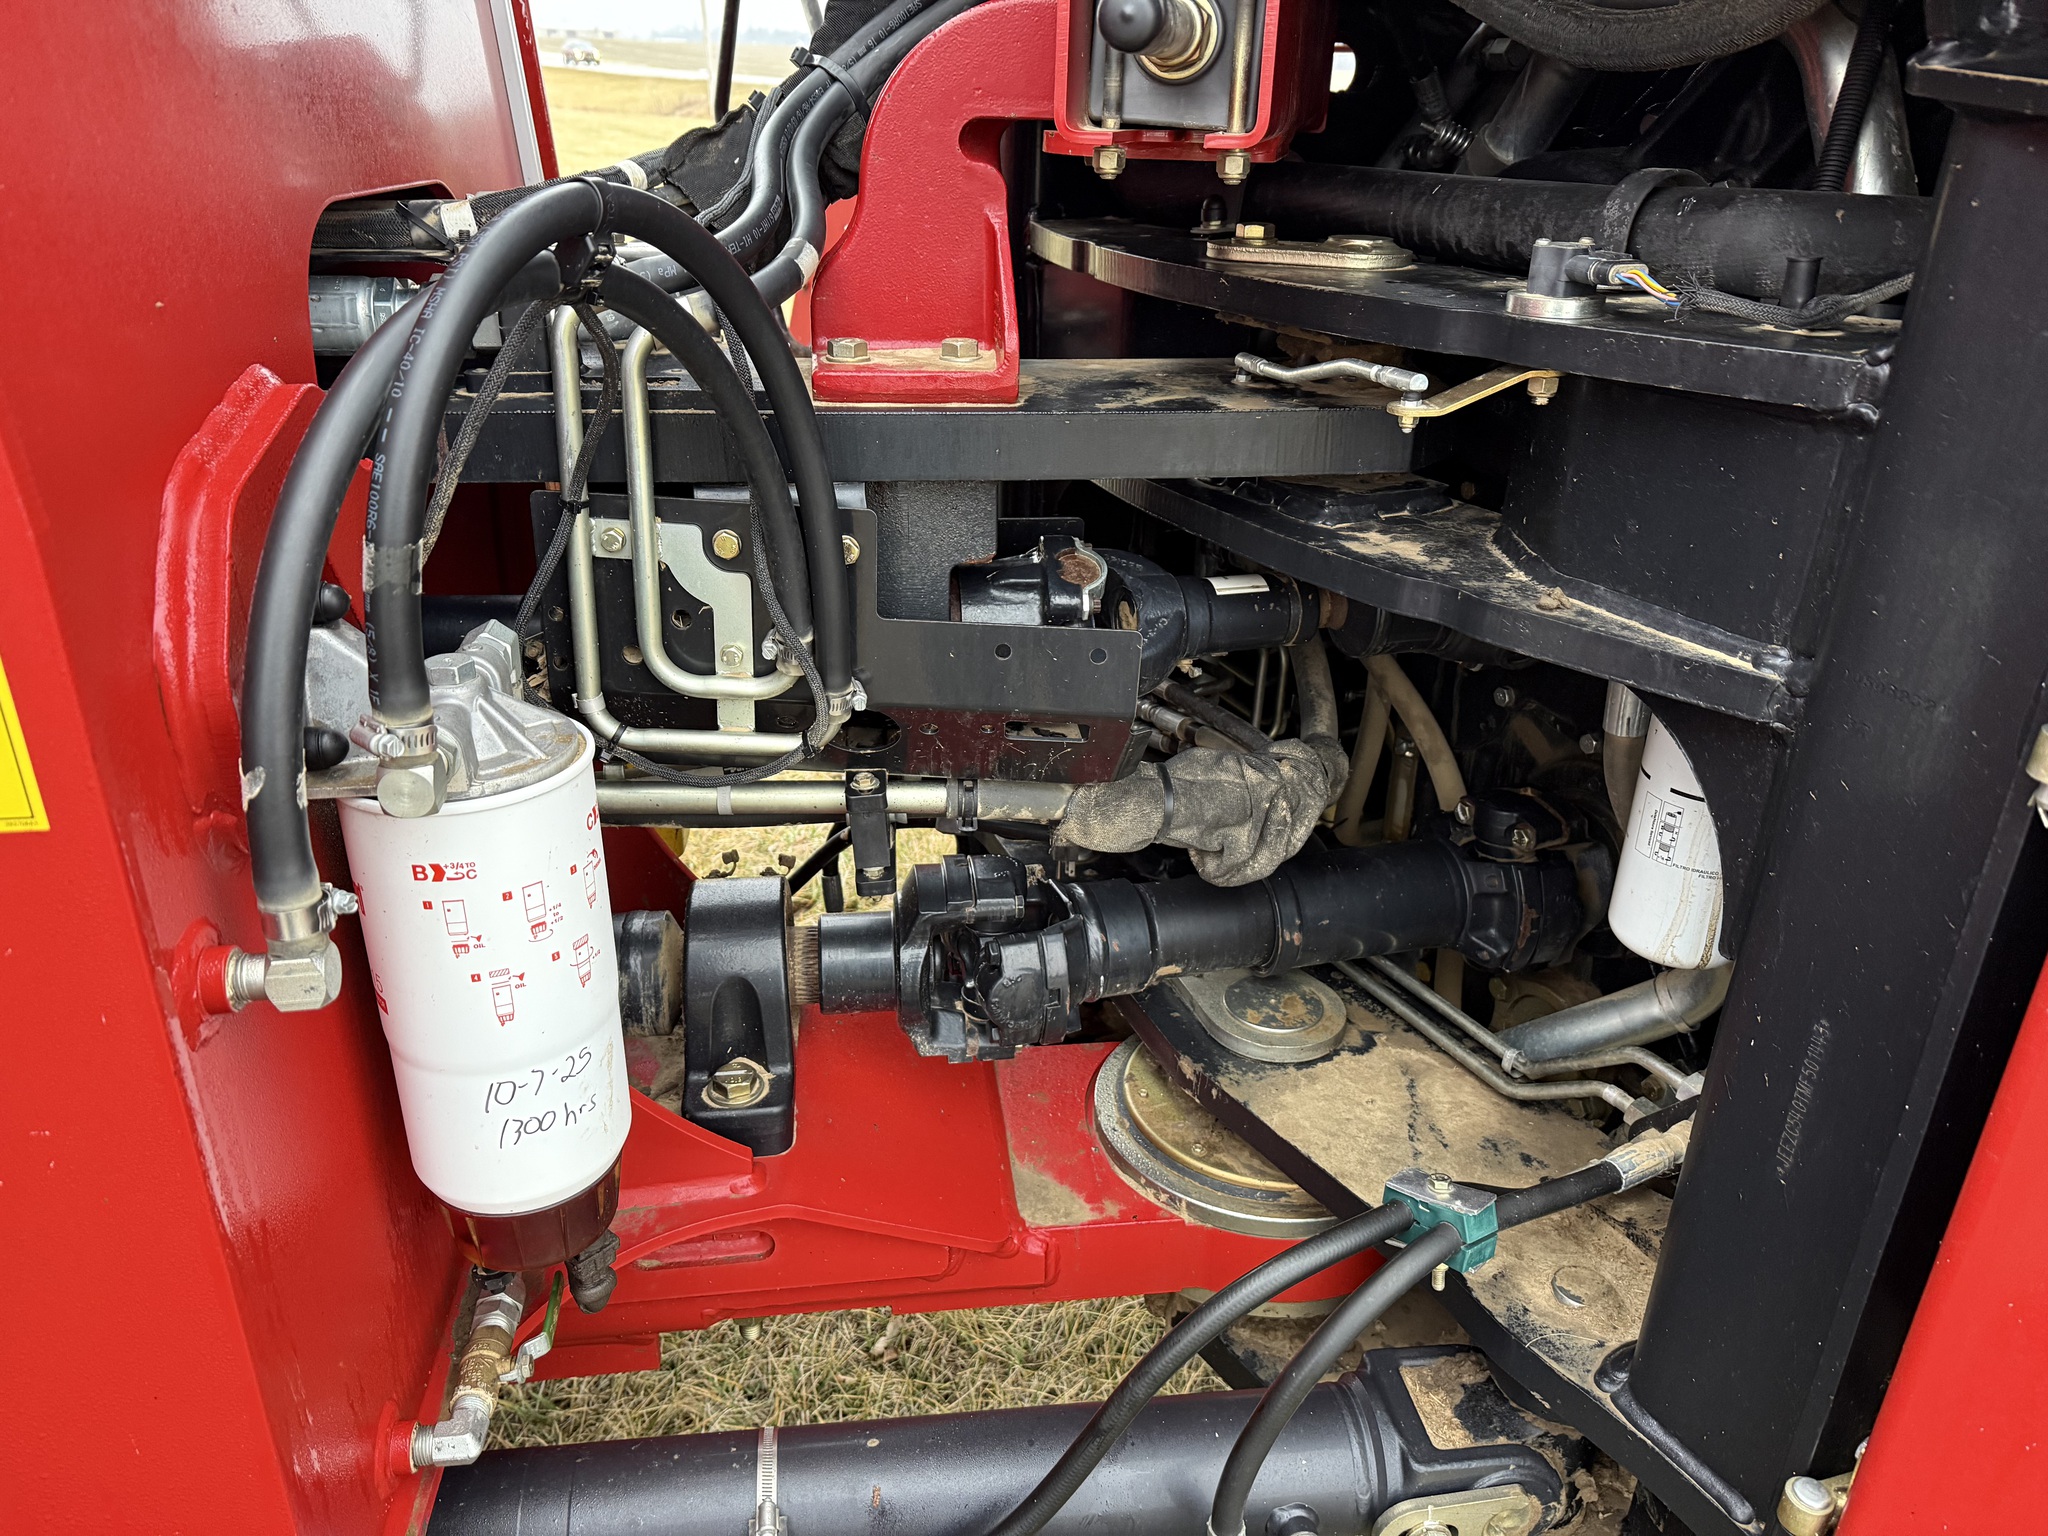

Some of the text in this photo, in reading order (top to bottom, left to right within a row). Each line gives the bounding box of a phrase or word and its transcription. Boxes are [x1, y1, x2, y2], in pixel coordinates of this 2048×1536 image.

[657, 264, 678, 278] MPa
[420, 286, 447, 320] MSHA
[391, 326, 426, 398] IC-40/10
[411, 864, 428, 881] B
[485, 1046, 592, 1114] 10-7-25
[500, 1093, 597, 1149] 1300 hrs
